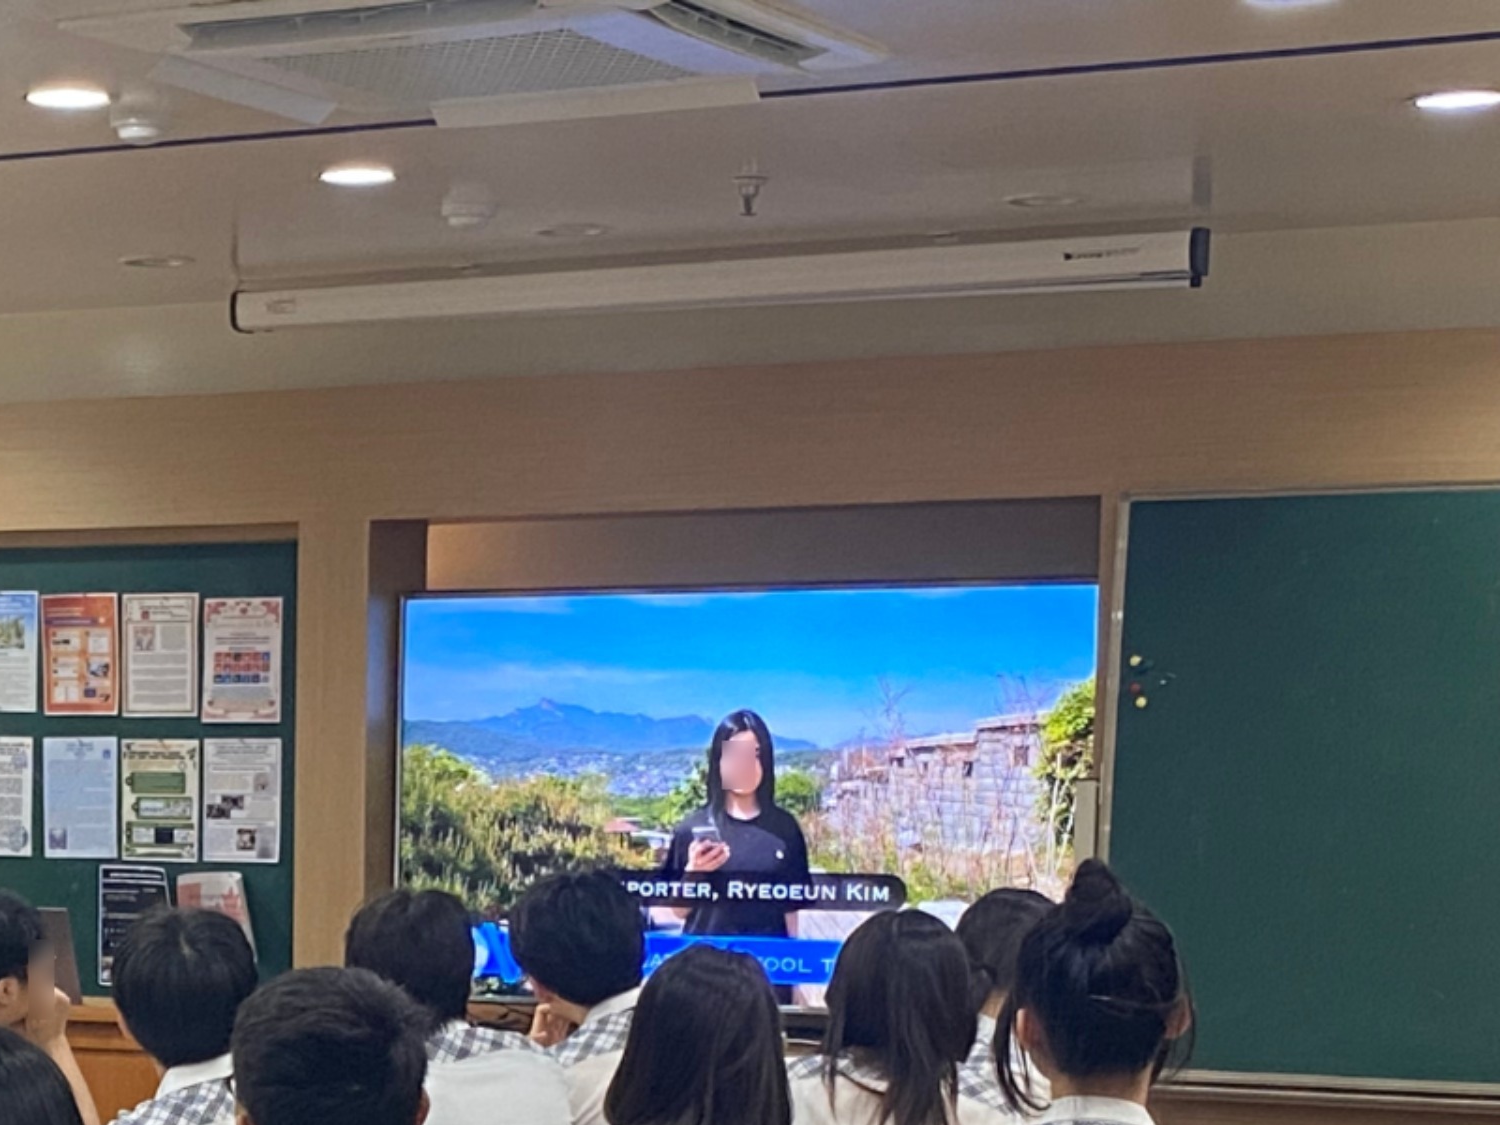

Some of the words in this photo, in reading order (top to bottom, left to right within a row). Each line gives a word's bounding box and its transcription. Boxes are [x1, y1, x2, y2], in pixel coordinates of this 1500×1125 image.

[621, 880, 719, 902] PORTER,
[846, 883, 890, 902] KIM
[758, 956, 812, 974] OOL
